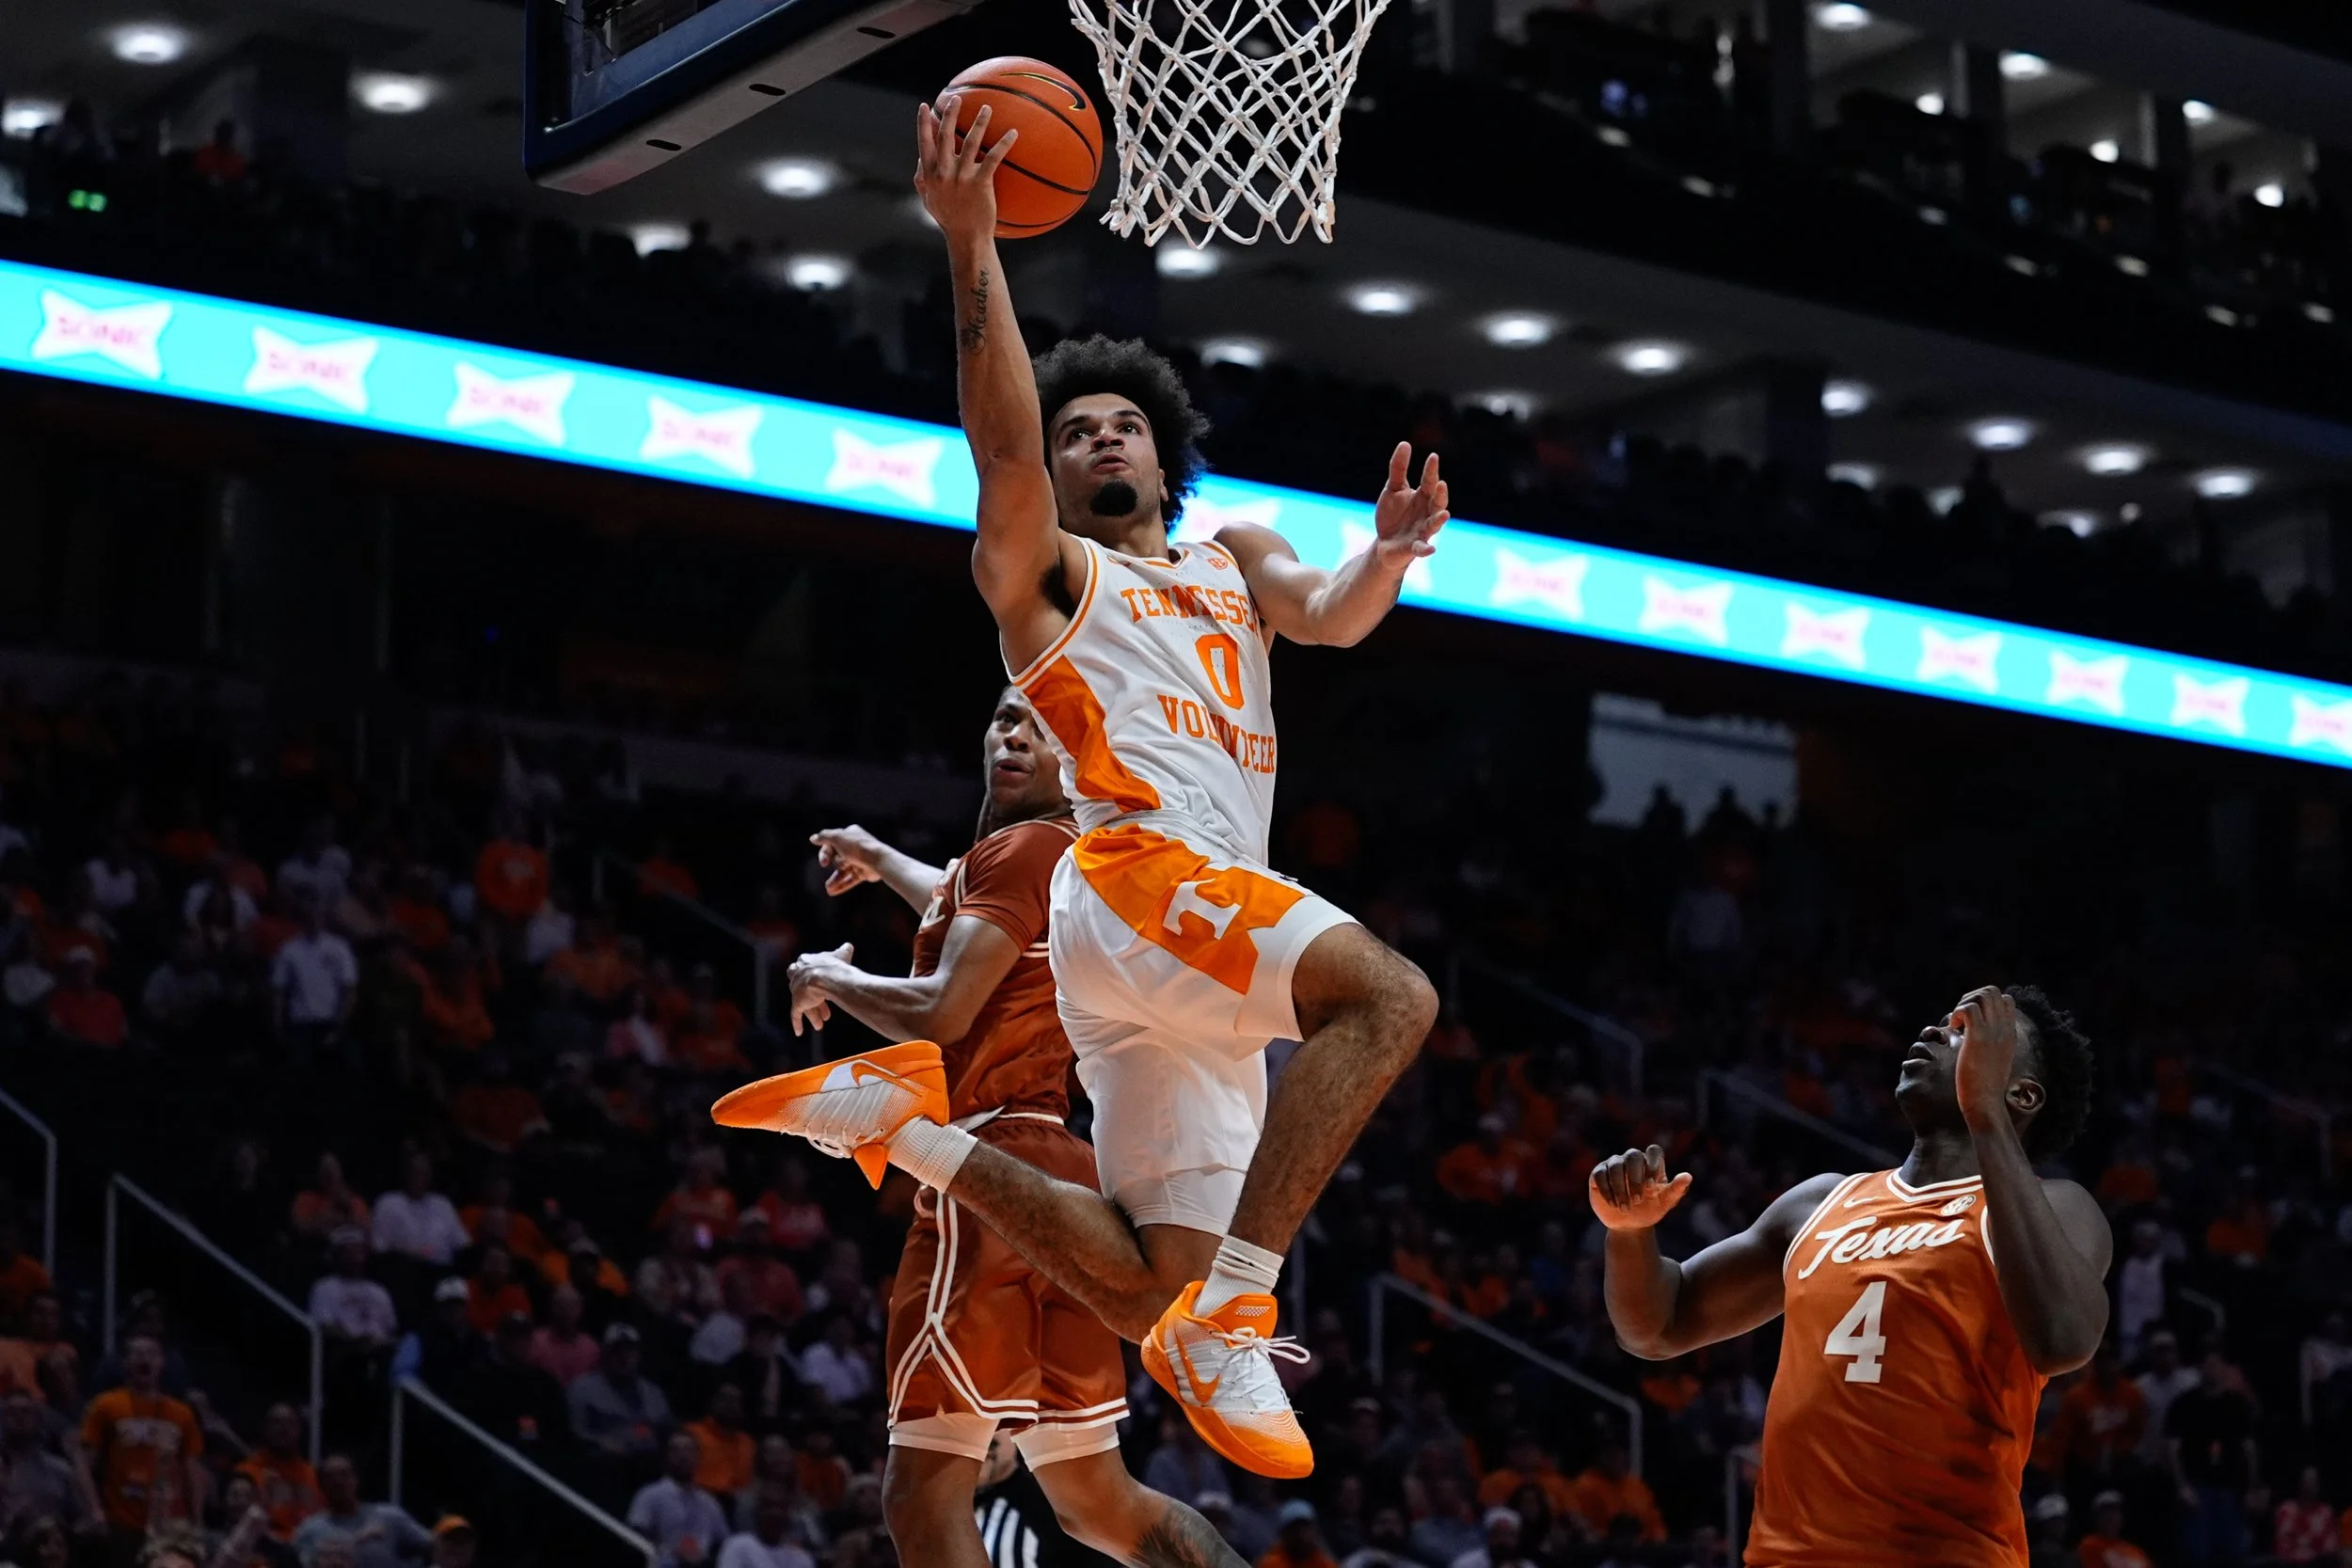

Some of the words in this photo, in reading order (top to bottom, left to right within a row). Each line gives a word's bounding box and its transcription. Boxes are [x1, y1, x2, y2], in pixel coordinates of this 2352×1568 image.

[1120, 584, 1257, 633] TENNESSE
[1195, 633, 1245, 710] 0
[1798, 1216, 1965, 1279] Texas
[1824, 1281, 1886, 1384] 4
